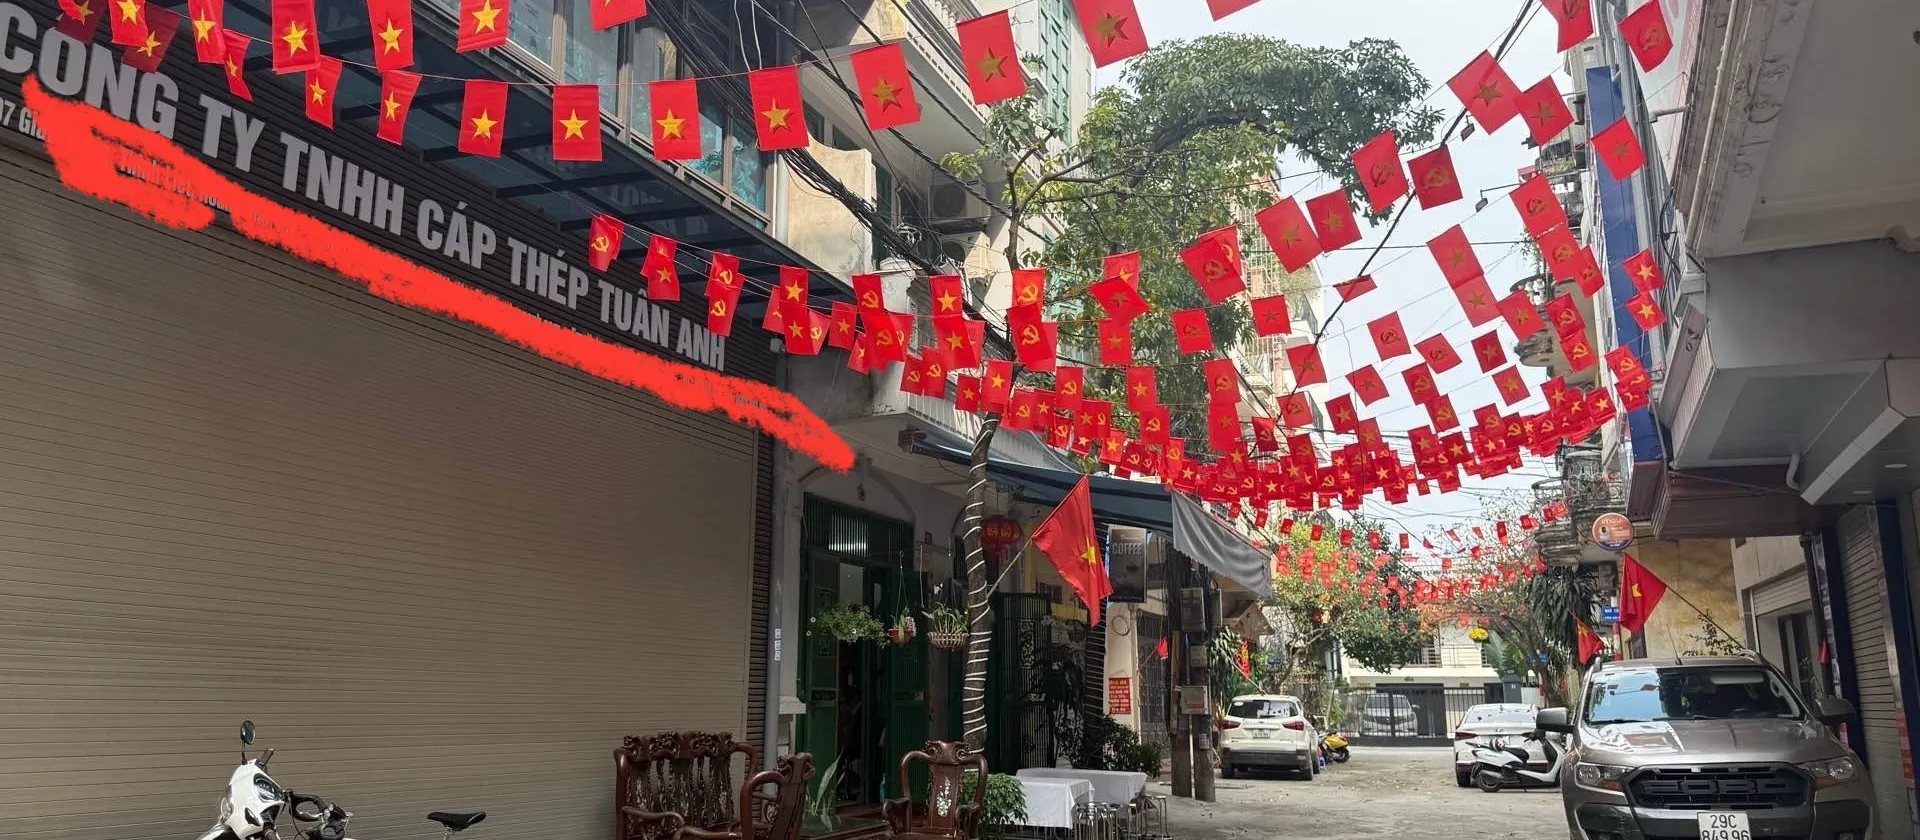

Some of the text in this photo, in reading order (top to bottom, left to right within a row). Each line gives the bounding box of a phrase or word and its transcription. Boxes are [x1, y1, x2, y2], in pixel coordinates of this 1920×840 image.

[199, 94, 266, 173] TY
[280, 131, 405, 236] TNHH
[416, 201, 497, 270] CÁP
[507, 236, 589, 310] THÉP
[676, 317, 726, 372] ANH
[1112, 542, 1144, 556] COFFEE
[1710, 814, 1737, 828] 29C
